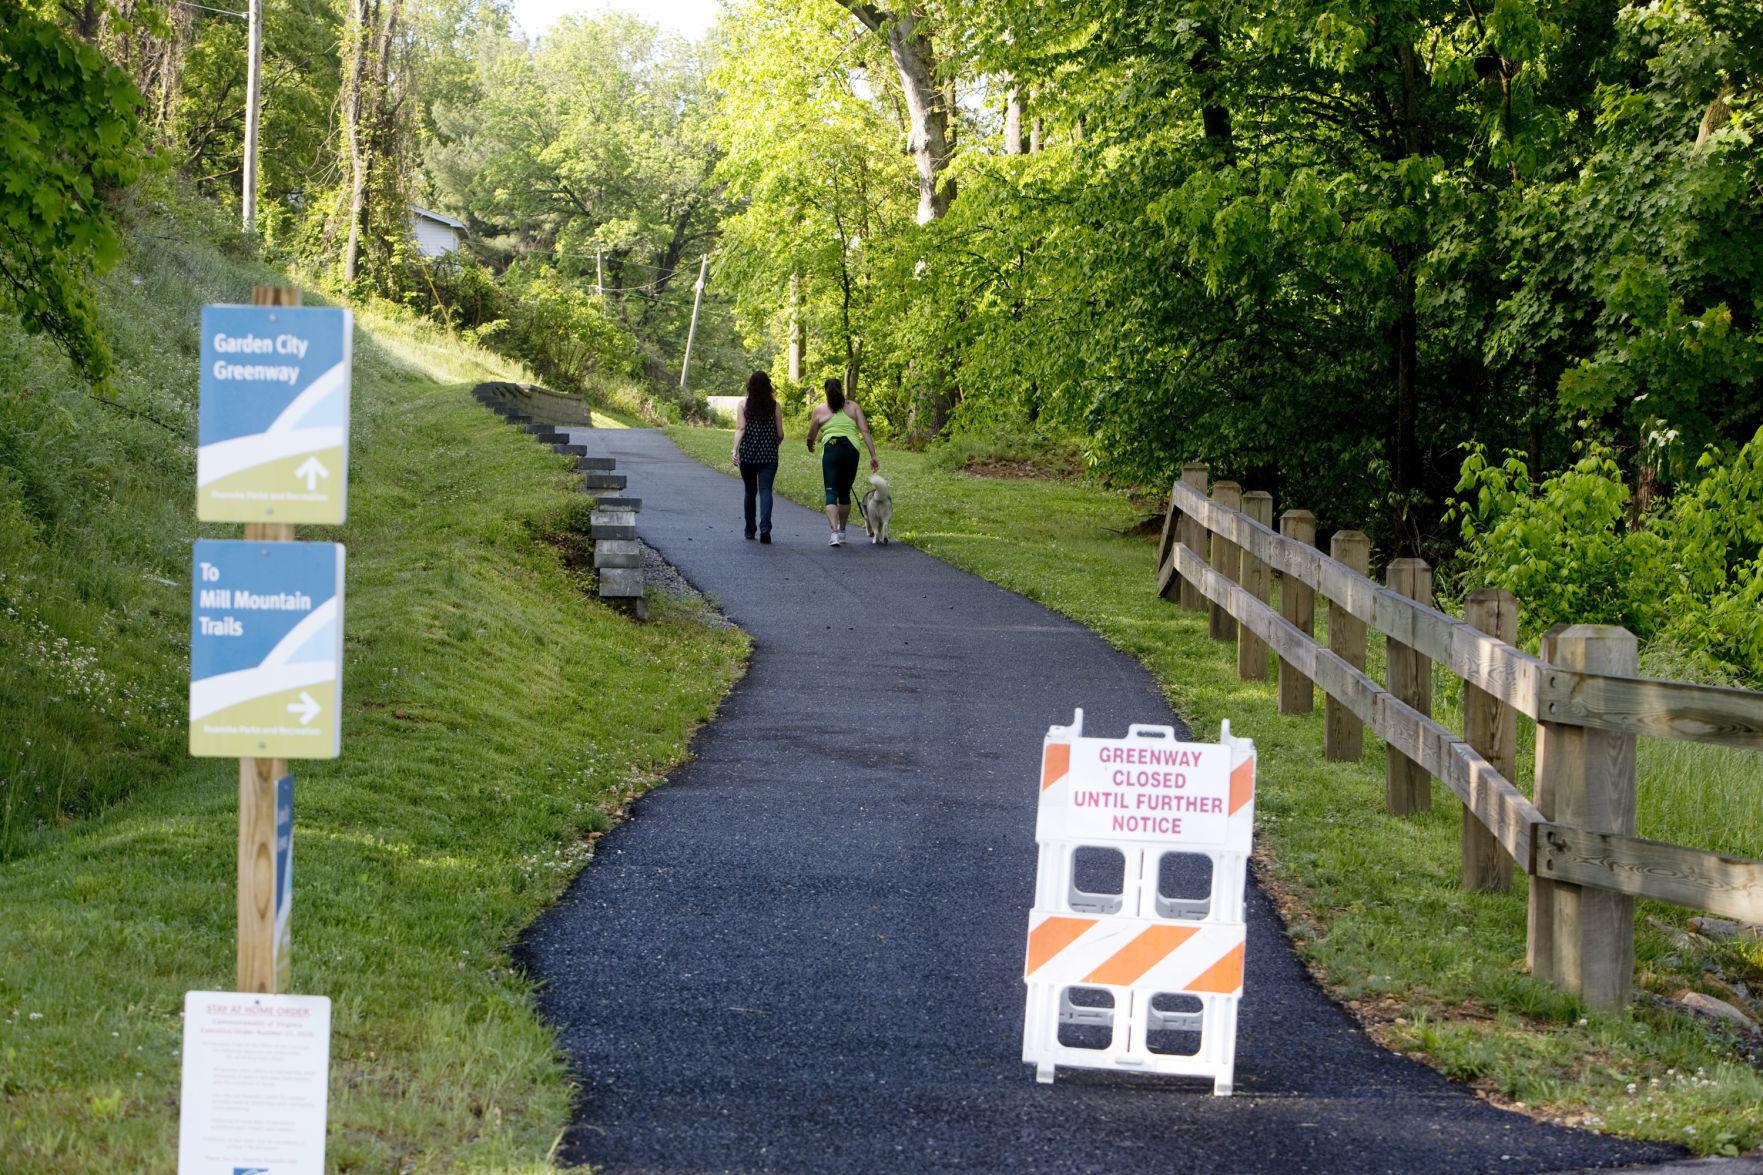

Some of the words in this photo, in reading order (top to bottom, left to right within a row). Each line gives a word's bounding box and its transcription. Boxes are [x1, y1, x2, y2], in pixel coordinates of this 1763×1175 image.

[213, 333, 273, 354] Garden
[275, 334, 308, 358] City
[213, 360, 300, 385] Greenway
[199, 562, 220, 582] To
[200, 589, 231, 609] Mill
[234, 590, 311, 611] Mountain
[199, 616, 243, 637] Trails
[1099, 747, 1203, 767] GREENWAY
[1112, 770, 1187, 789] CLOSED
[1074, 791, 1130, 809] UNTIL
[1136, 793, 1223, 814] FURTHER
[1112, 815, 1182, 834] NOTICE
[245, 1006, 273, 1016] HOME
[277, 1007, 310, 1017] ORDER
